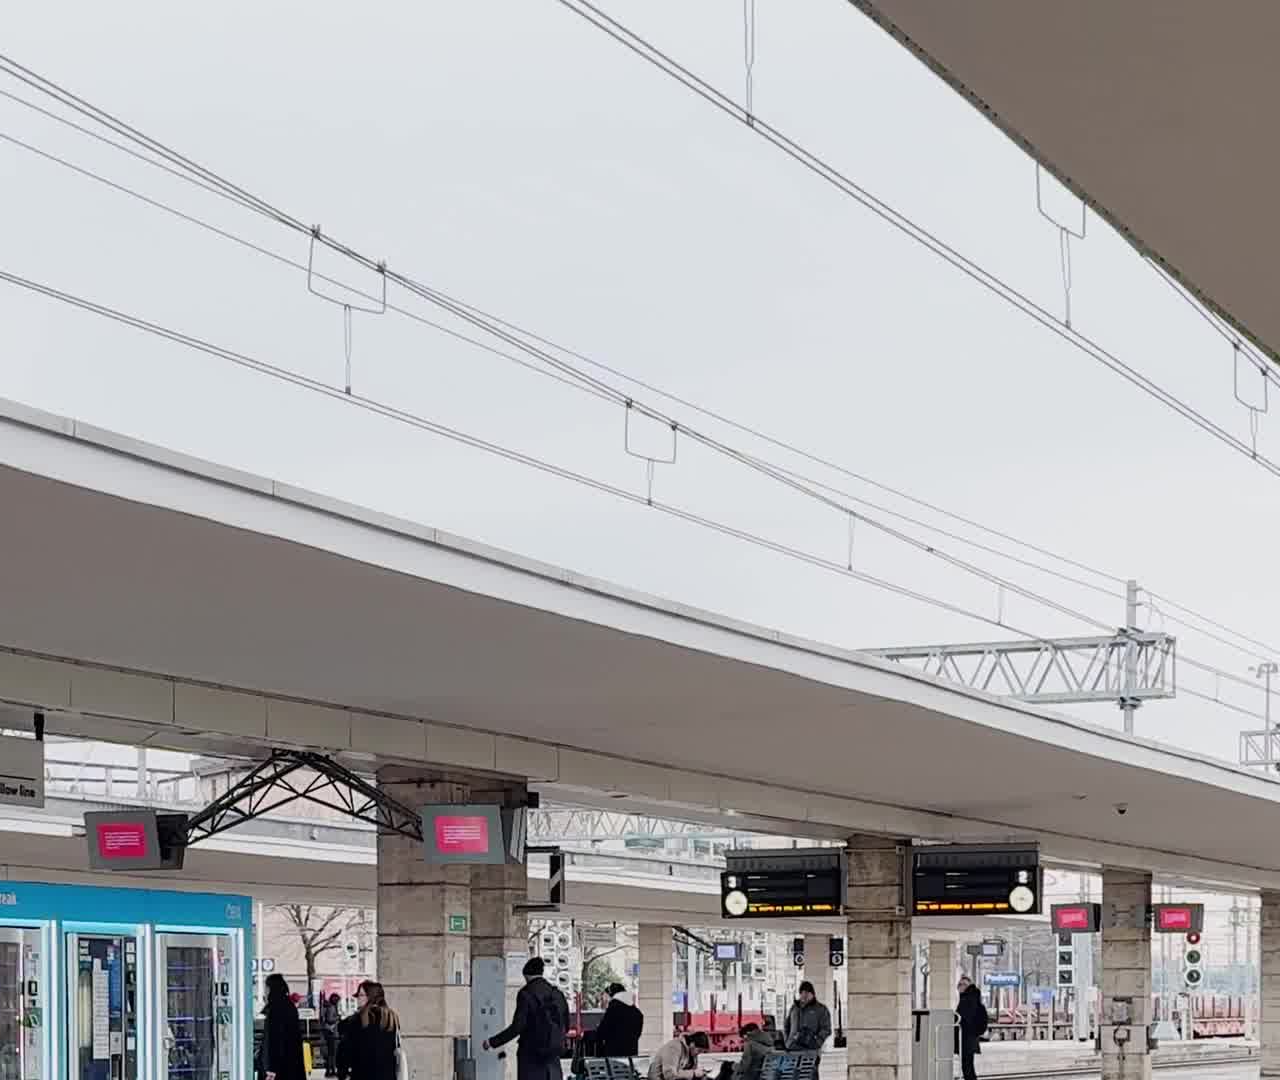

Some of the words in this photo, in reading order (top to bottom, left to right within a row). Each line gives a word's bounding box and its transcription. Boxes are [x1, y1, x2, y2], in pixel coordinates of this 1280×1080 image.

[19, 783, 36, 798] line
[728, 876, 736, 888] 3
[1018, 870, 1027, 884] 2
